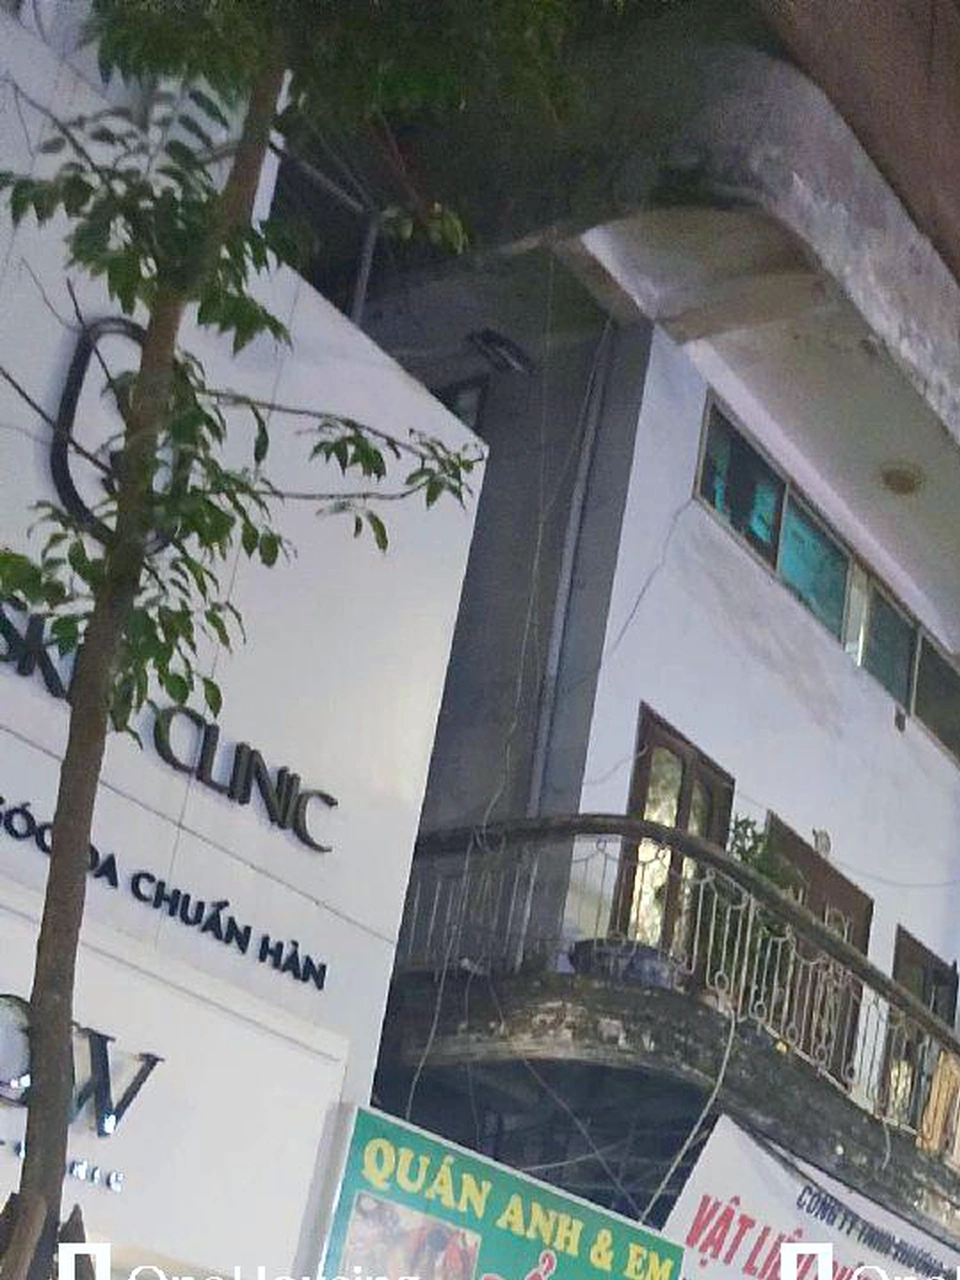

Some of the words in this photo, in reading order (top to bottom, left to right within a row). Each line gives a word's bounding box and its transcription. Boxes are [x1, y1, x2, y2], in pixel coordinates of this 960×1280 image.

[153, 703, 338, 852] CLINIC
[259, 933, 326, 990] HÀN
[361, 1137, 492, 1220] QUÁN
[496, 1193, 585, 1257] ANH
[589, 1227, 613, 1272] &
[685, 1194, 757, 1267] VẬT
